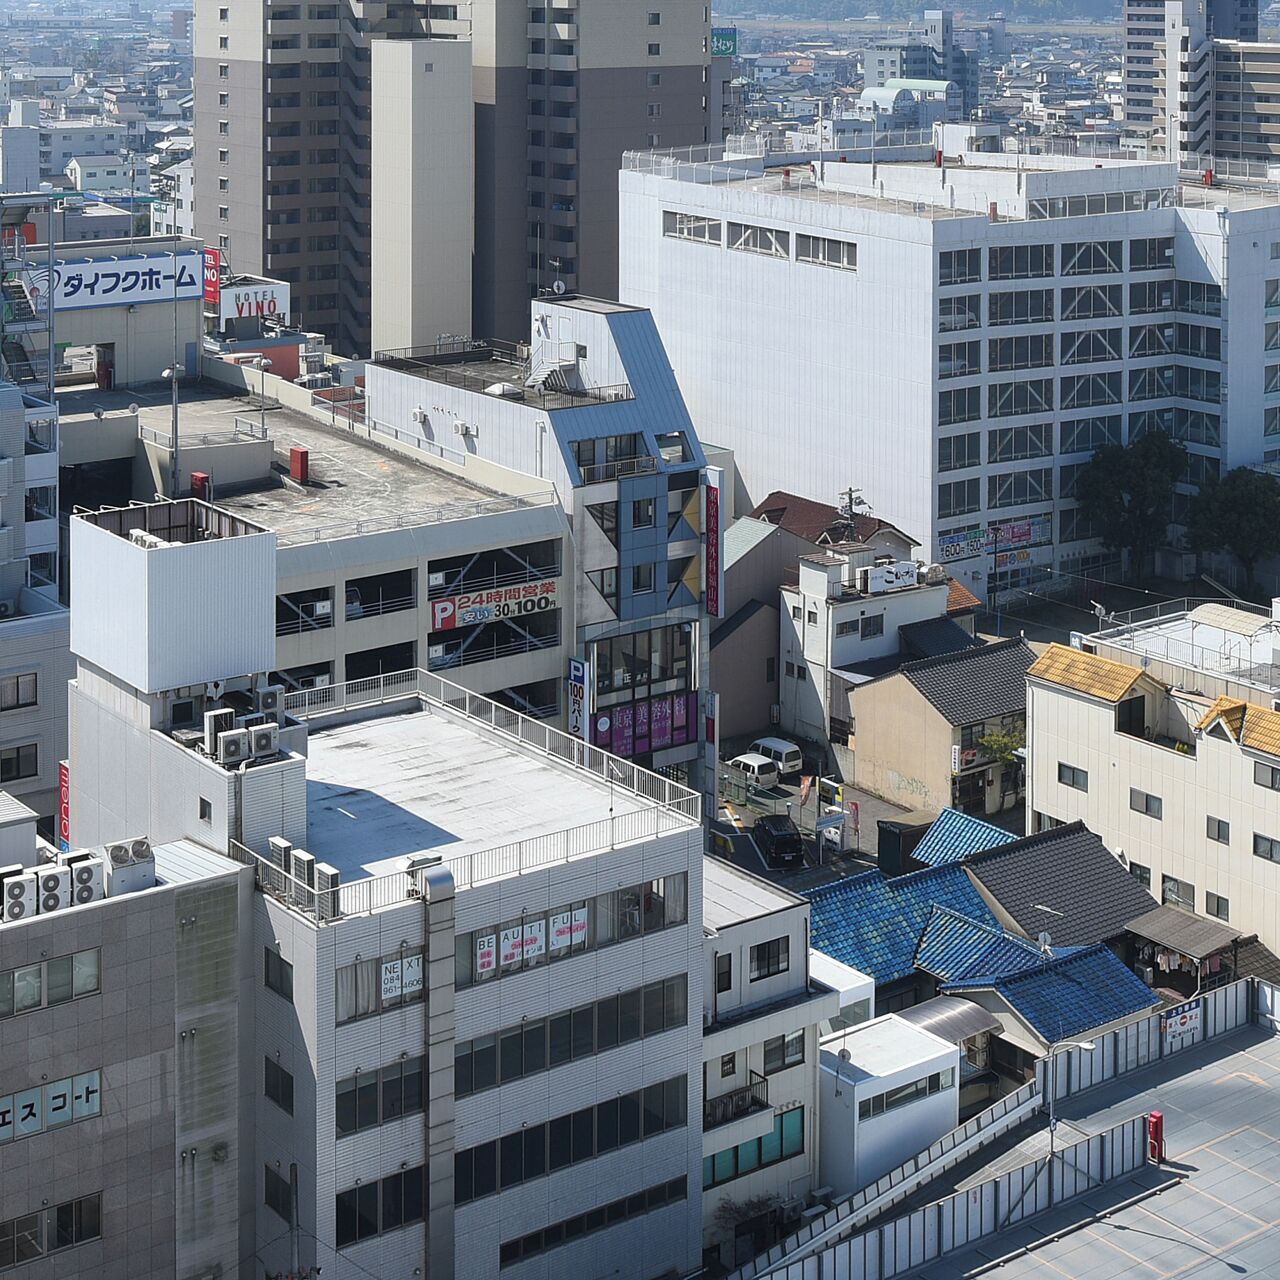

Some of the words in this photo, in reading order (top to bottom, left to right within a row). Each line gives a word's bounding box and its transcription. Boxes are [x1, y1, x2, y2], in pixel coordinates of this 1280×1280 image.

[204, 254, 215, 265] TEL
[63, 265, 196, 298] ダイフクホーム
[204, 267, 217, 281] NO
[235, 290, 277, 302] HOTEL
[236, 300, 277, 317] VINO
[458, 581, 556, 610] 24時間営業
[435, 601, 455, 629] P
[463, 610, 488, 622] 安い
[570, 661, 583, 680] P
[569, 682, 584, 733] 100円パーク
[613, 696, 685, 729] 東京美容外科
[385, 956, 421, 976] NEXT
[383, 974, 400, 985] 084
[383, 978, 422, 995] 961-4606
